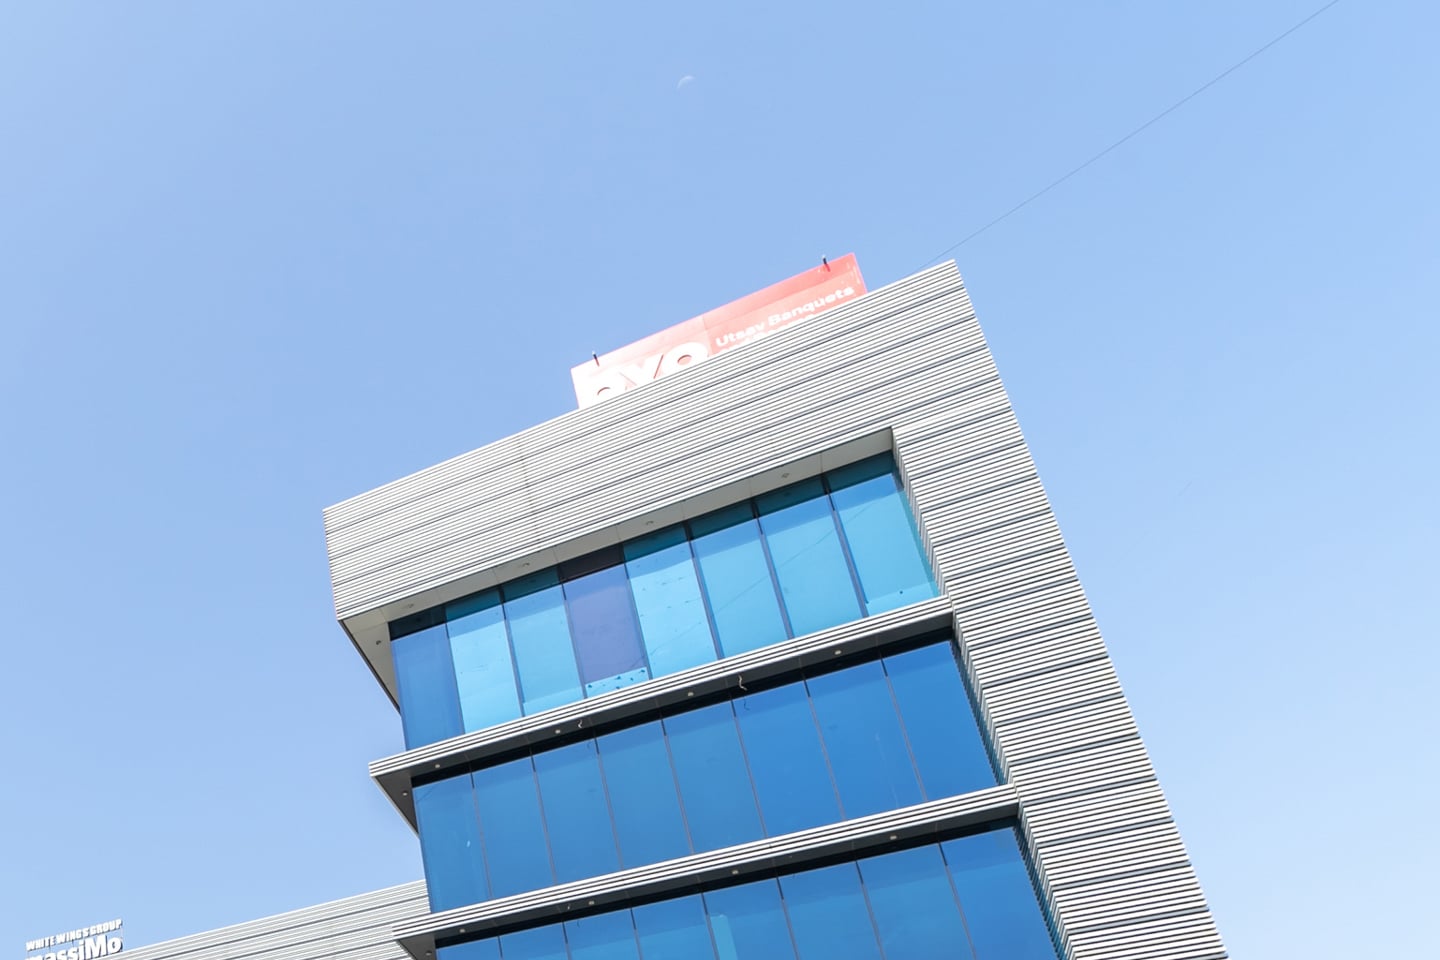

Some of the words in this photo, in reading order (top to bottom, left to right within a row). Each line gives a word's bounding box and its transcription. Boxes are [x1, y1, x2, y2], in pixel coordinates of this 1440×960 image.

[715, 321, 766, 348] Utsav
[767, 286, 856, 328] Banquets
[26, 936, 55, 951] WHITE
[56, 927, 90, 944] WINGS
[90, 918, 123, 936] GROUP
